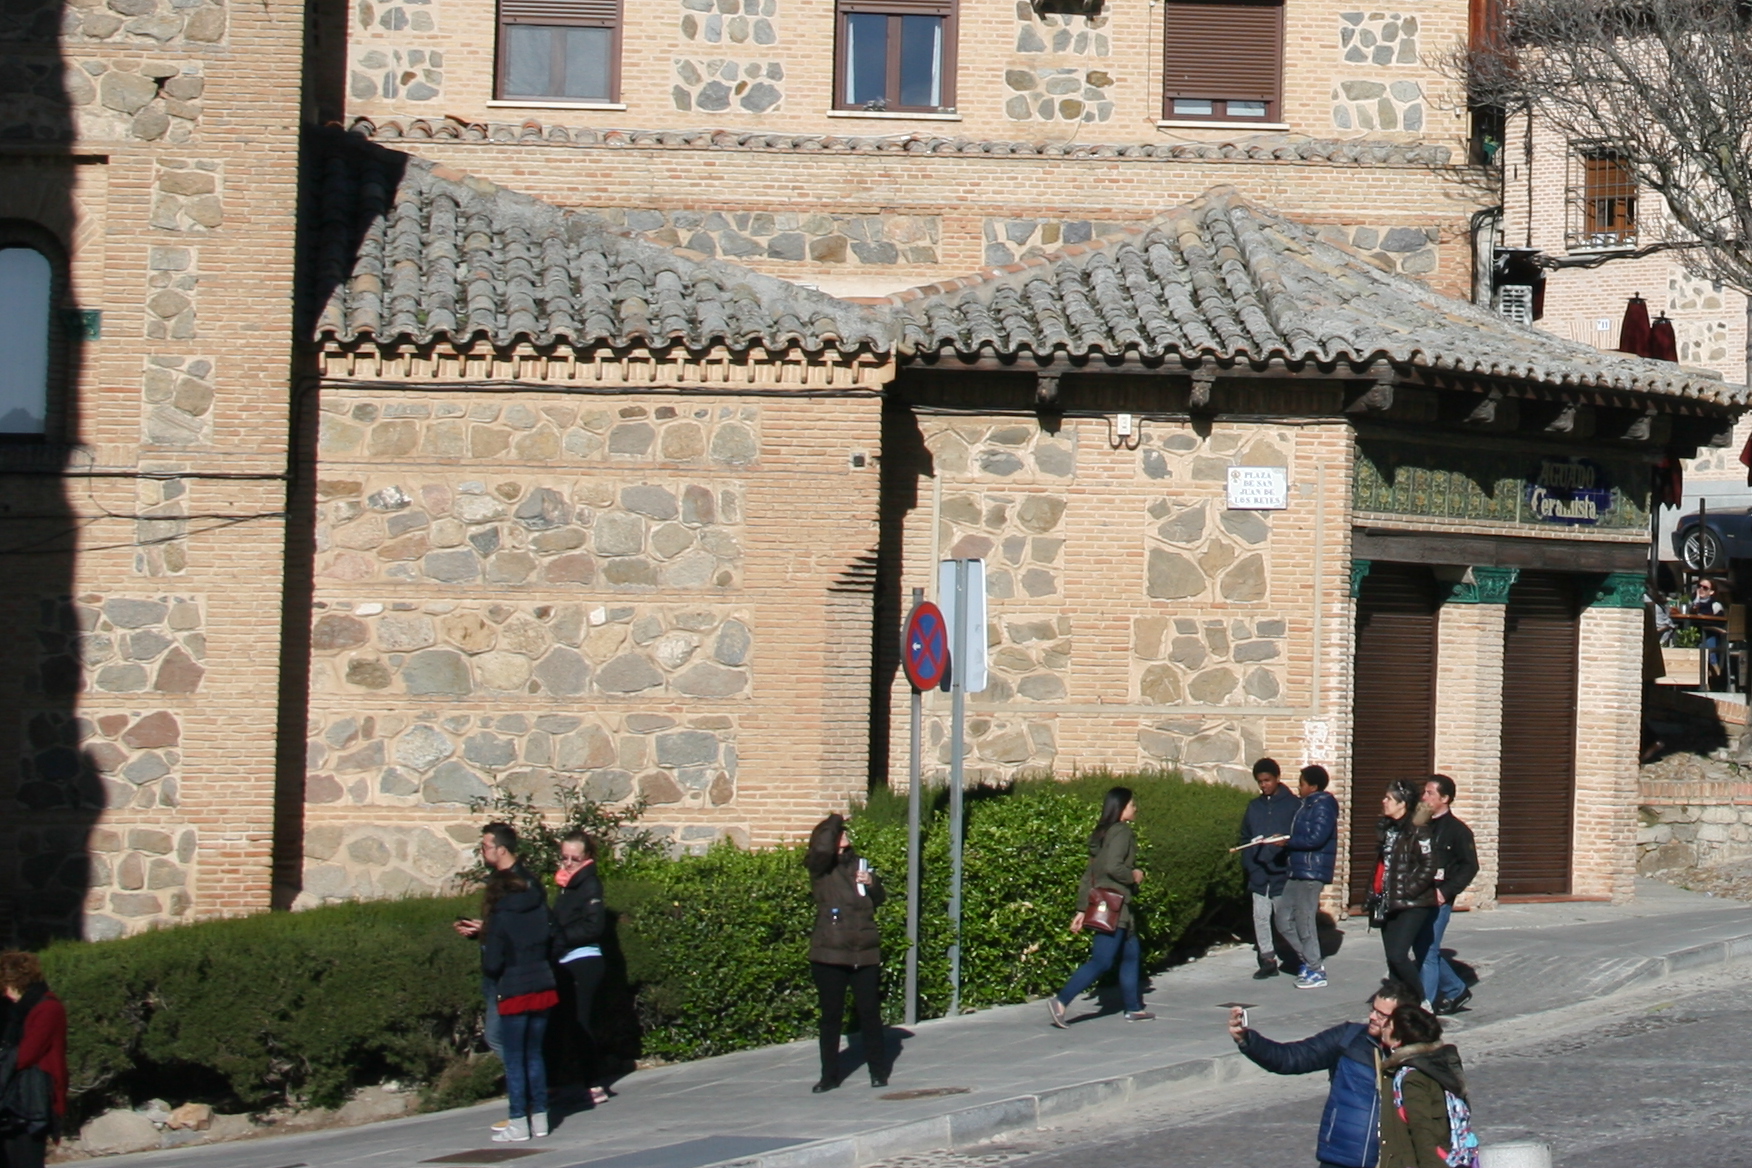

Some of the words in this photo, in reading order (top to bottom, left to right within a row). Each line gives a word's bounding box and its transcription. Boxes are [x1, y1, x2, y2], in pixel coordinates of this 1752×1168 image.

[1540, 461, 1595, 489] AGUADO
[1239, 488, 1261, 496] JUAN
[1264, 488, 1276, 496] DE
